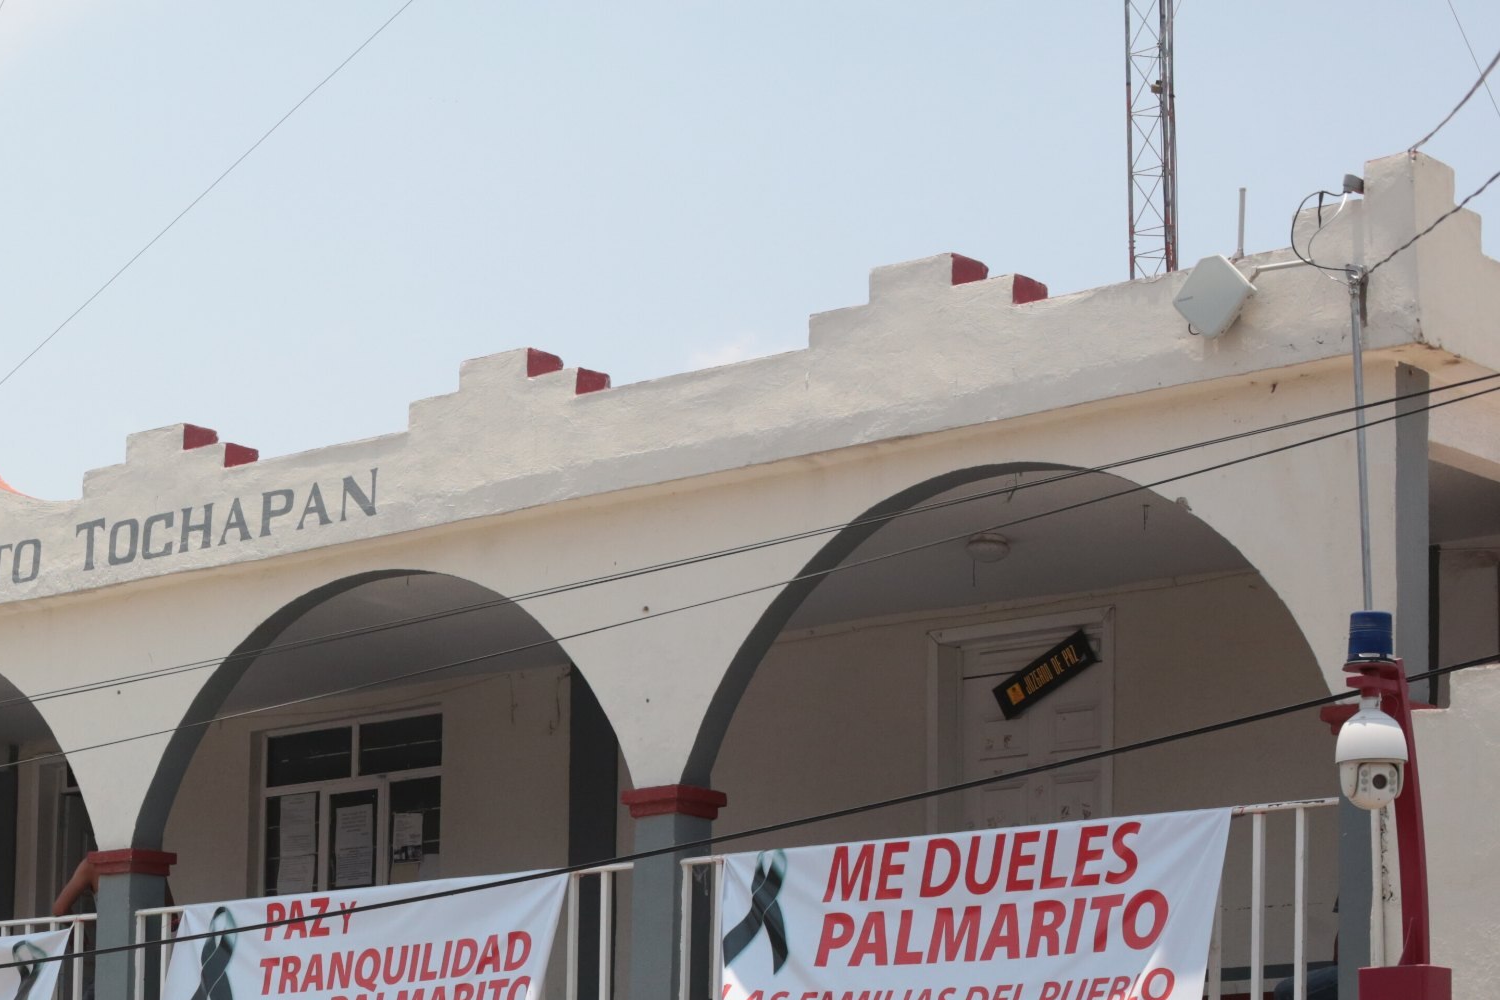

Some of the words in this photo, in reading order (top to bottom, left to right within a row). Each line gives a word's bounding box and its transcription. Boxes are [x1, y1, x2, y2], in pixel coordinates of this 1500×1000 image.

[75, 467, 379, 573] TOCHAPAN
[1023, 662, 1054, 695] JUZGADO
[1050, 654, 1065, 675] DE
[1062, 645, 1079, 668] PAZ
[822, 841, 909, 903] ME
[920, 821, 1142, 898] DUELES
[264, 897, 330, 941] PAZ
[340, 901, 357, 934] Y
[814, 889, 1170, 968] PALMARITO
[259, 930, 532, 995] TRANQUILIDAD
